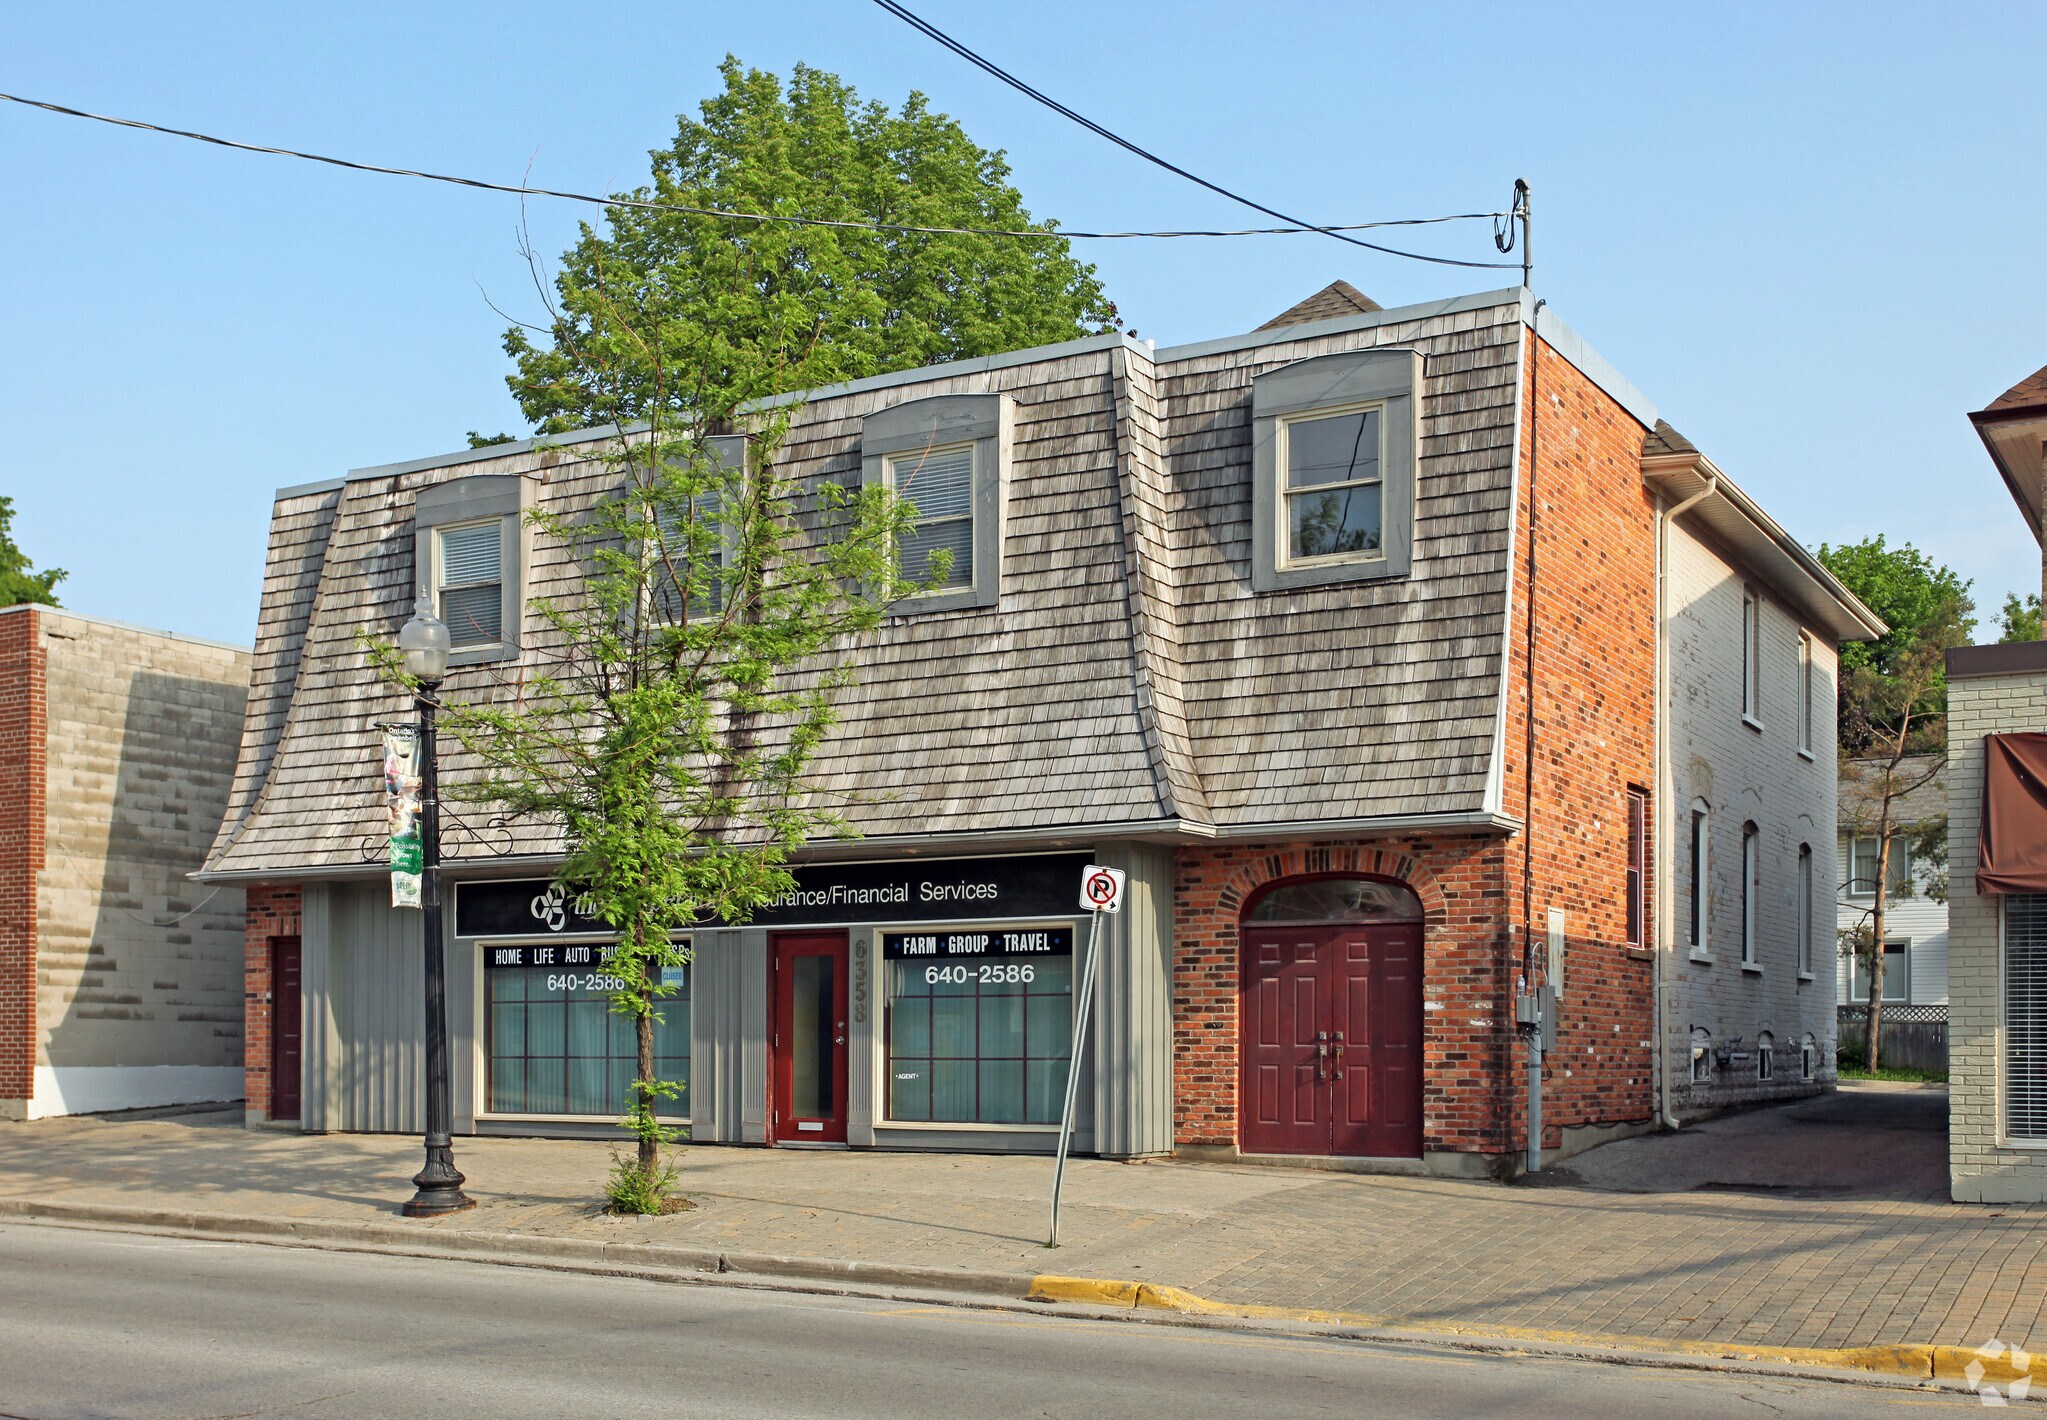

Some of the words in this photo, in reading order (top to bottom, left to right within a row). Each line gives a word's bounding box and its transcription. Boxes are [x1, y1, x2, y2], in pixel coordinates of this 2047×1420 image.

[919, 880, 998, 902] Services
[1093, 878, 1110, 899] P
[903, 936, 937, 955] FARM
[948, 934, 990, 954] GROUP
[1003, 933, 1051, 952] TRAVEL
[495, 949, 522, 965] HOME
[533, 948, 555, 965] LIFE
[564, 946, 591, 963] AUTO
[546, 973, 626, 992] 640-2586
[662, 972, 684, 981] CLOSED
[925, 964, 1036, 985] 640-2586
